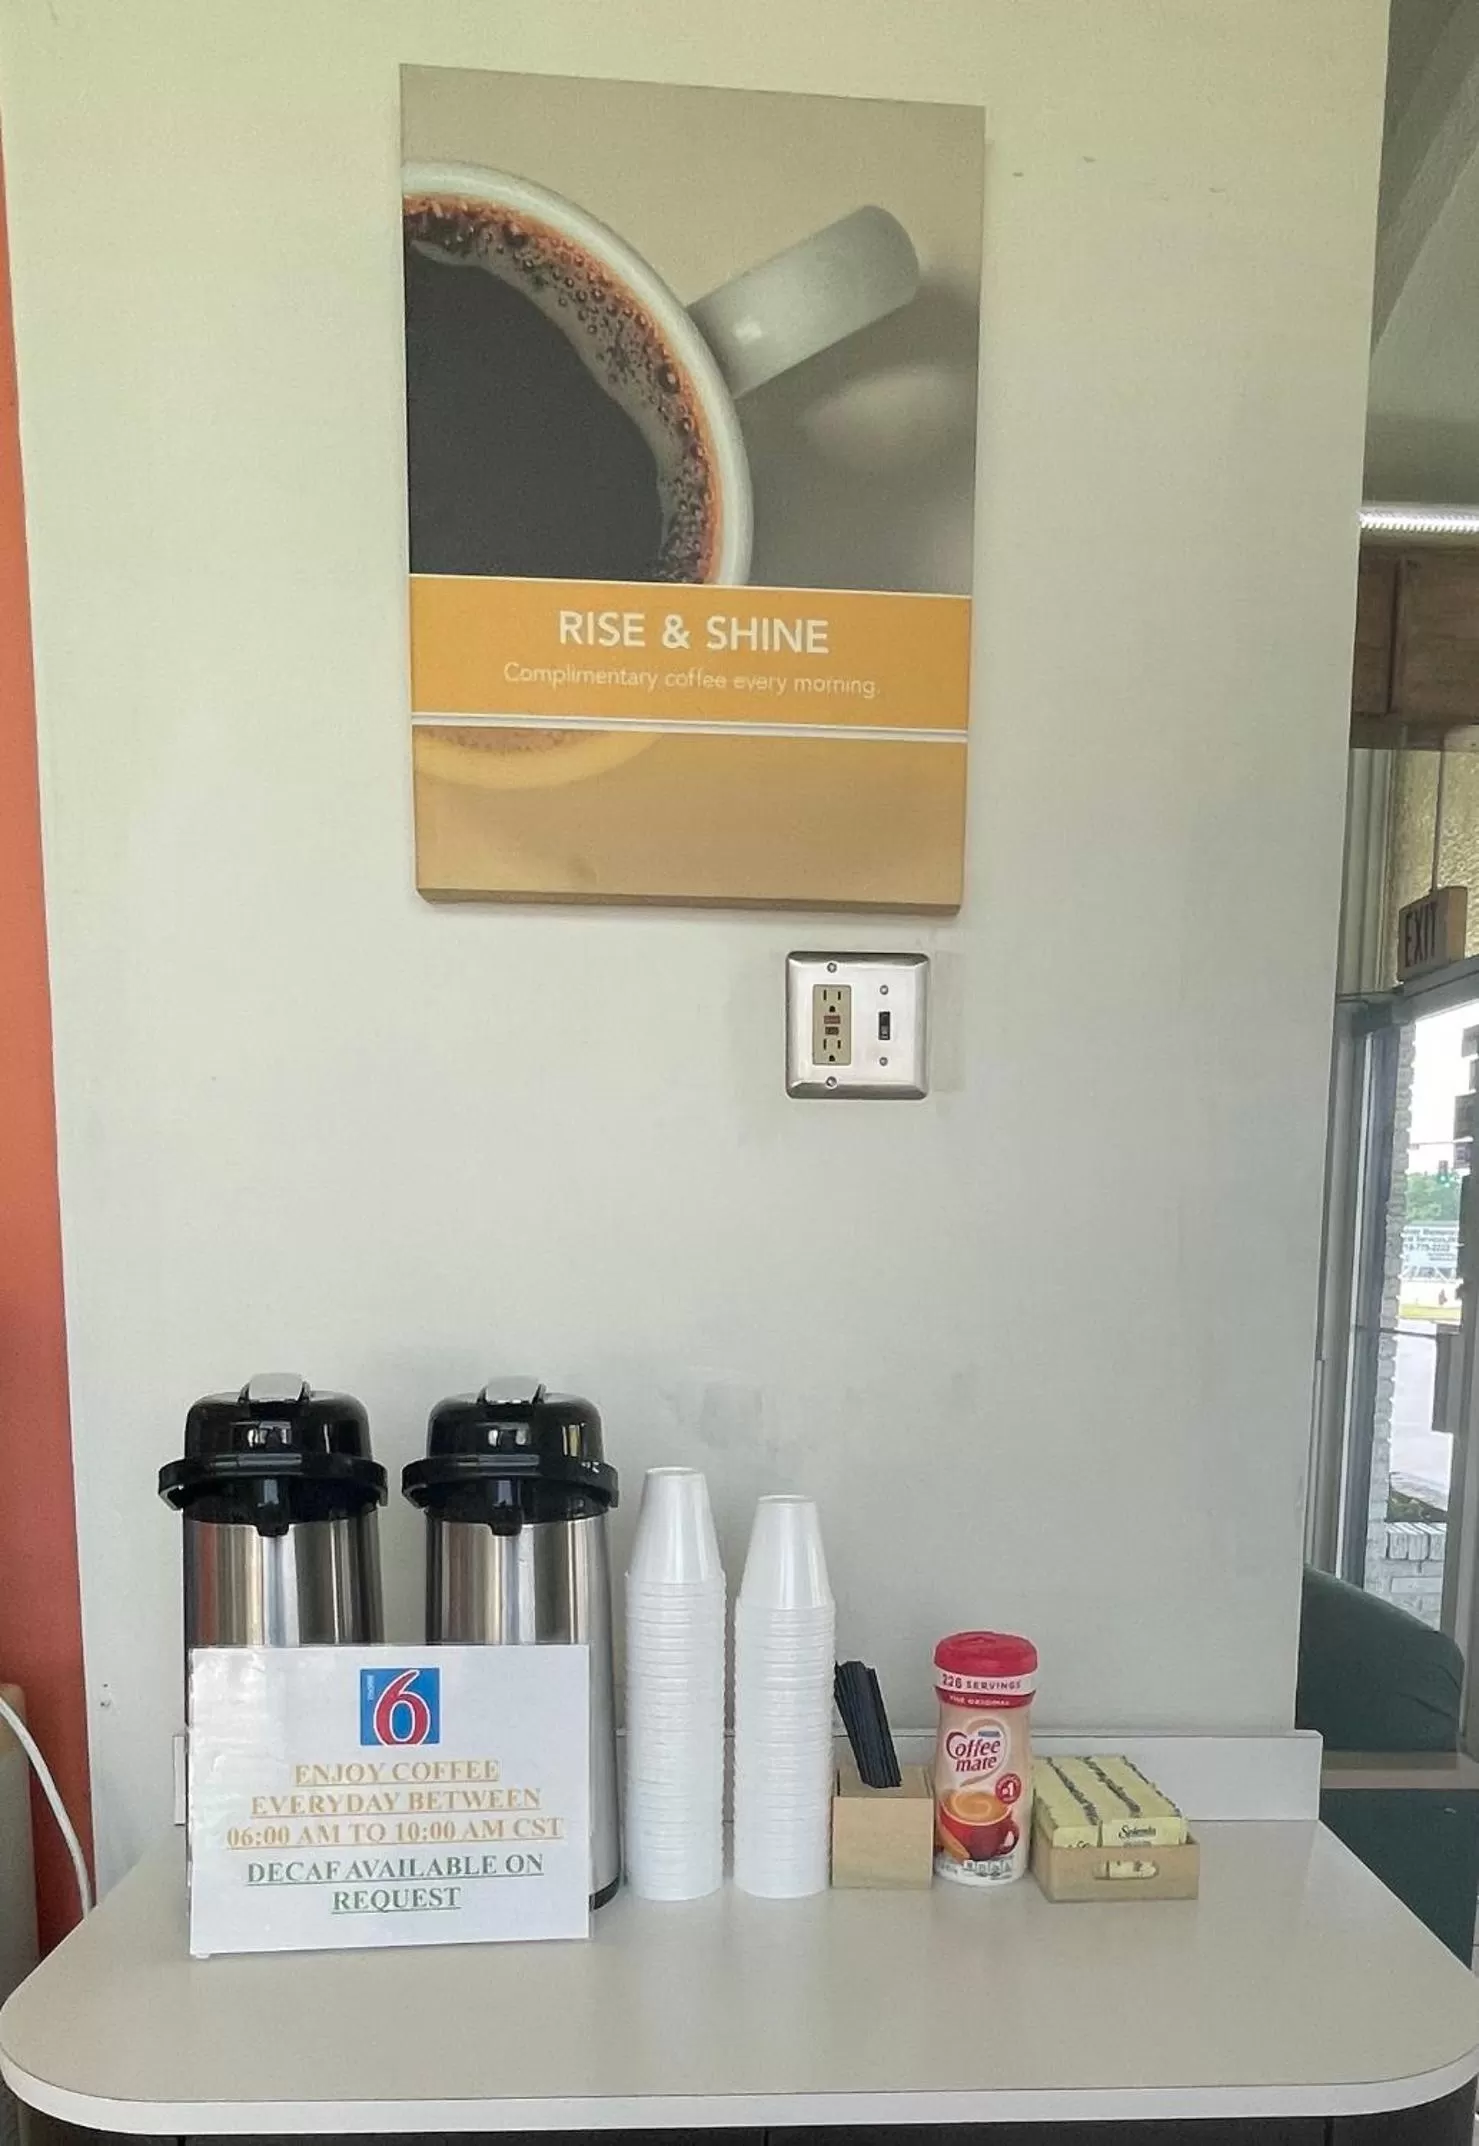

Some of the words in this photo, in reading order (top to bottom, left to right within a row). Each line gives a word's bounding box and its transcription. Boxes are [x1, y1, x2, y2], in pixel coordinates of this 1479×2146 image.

[559, 610, 646, 648] RISE
[661, 614, 690, 650] &
[706, 615, 830, 654] SHINE
[503, 661, 658, 691] Complimentary
[664, 666, 728, 690] coffee
[733, 673, 788, 696] every
[1404, 902, 1438, 968] EXIT
[942, 1674, 962, 1690] 226
[965, 1680, 1022, 1690] SERVINGS
[373, 1669, 432, 1746] 6
[946, 1731, 1001, 1760] Coffee
[293, 1762, 386, 1785] ENJOY
[391, 1759, 500, 1782] COFFEE
[955, 1756, 998, 1773] mate
[250, 1792, 400, 1817] EVERYDAY
[407, 1787, 542, 1811] BETWEEN
[226, 1824, 290, 1848] 06:00
[298, 1823, 341, 1845] AM
[347, 1822, 387, 1843] TO
[396, 1820, 456, 1842] 10:00
[462, 1818, 505, 1840] AM
[512, 1816, 564, 1839] CST
[247, 1860, 341, 1884] DECAF
[343, 1854, 498, 1879] AVAILABLE
[504, 1853, 545, 1874] ON
[332, 1886, 461, 1912] REQUEST
